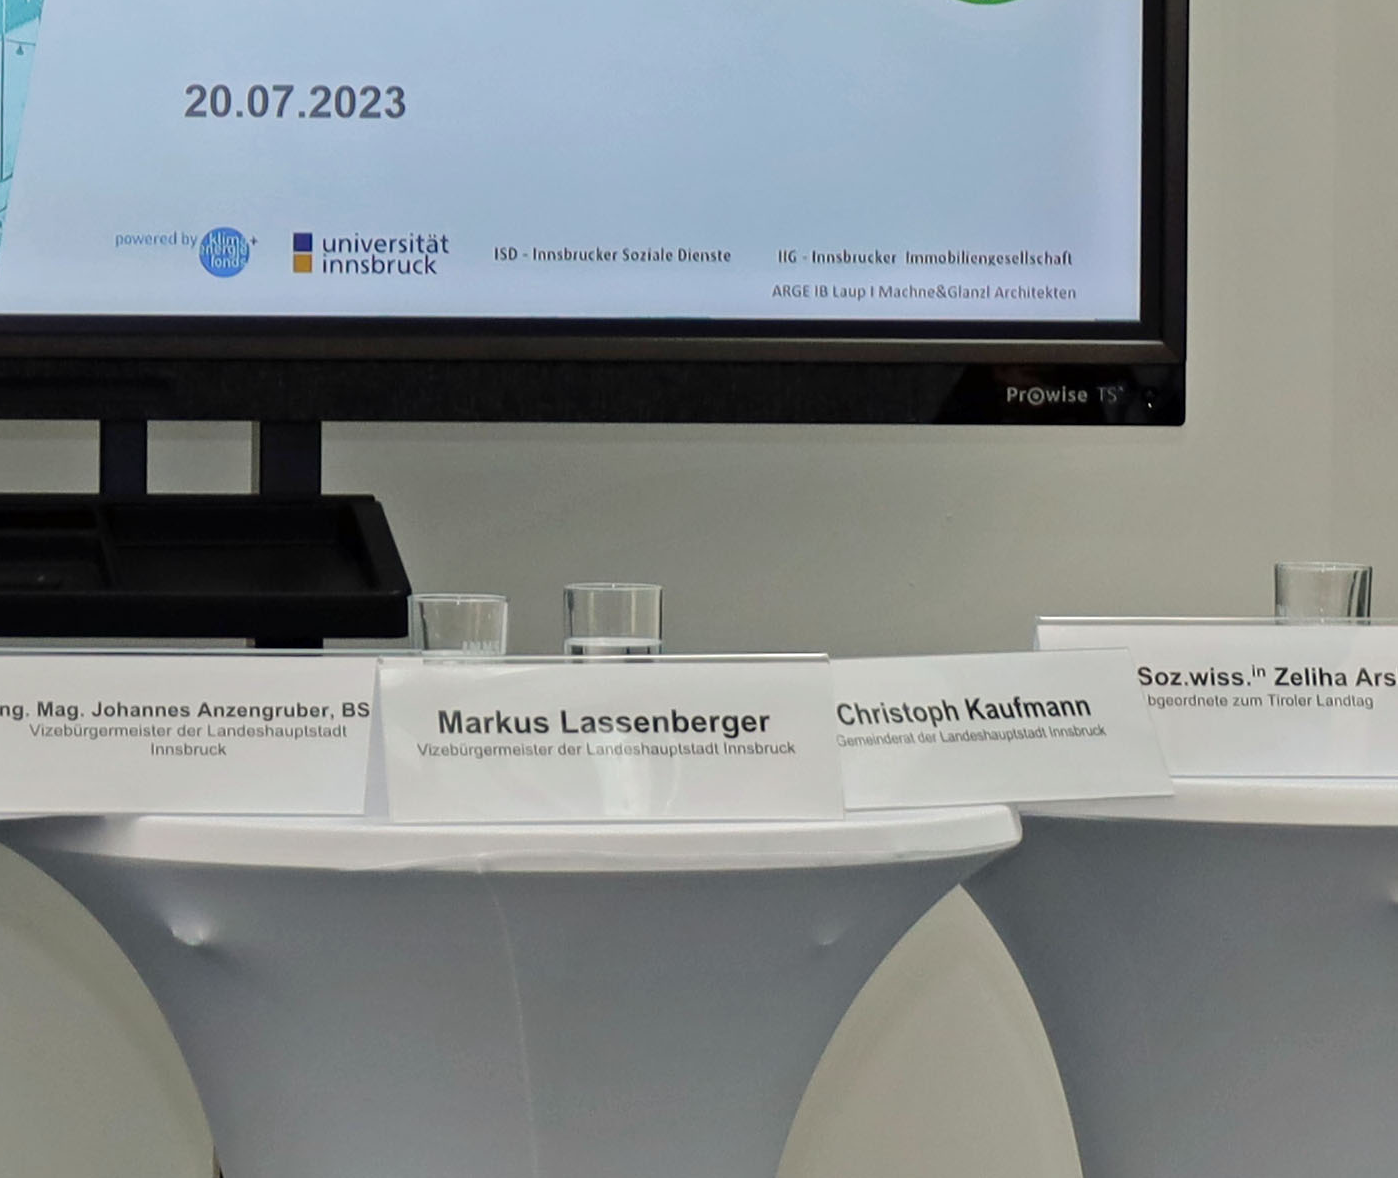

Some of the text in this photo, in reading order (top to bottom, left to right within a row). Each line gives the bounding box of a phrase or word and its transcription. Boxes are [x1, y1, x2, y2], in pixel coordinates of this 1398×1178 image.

[184, 84, 406, 119] 20.07.2023
[115, 231, 198, 249] powered by
[321, 232, 450, 255] universität
[321, 254, 438, 275] innsbruck
[493, 247, 519, 262] ISD
[532, 247, 618, 263] Innsbrucker
[621, 248, 674, 263] Soziale
[677, 249, 732, 264] Dienste
[777, 250, 798, 264] IIG
[811, 249, 897, 264] Innsbrucker
[905, 249, 1073, 266] Immobiliengesellschaft
[772, 284, 811, 298] ARGE
[833, 284, 866, 301] Laup
[878, 283, 991, 299] Machne&Glanzl
[993, 284, 1077, 299] Architekten
[1273, 667, 1348, 688] Zeliha
[36, 700, 85, 723] Mag.
[91, 700, 192, 719] Johannes
[196, 701, 335, 723] Anzengruber,
[341, 701, 371, 719] BS
[836, 694, 1092, 729] Christoph Kaufmann
[1147, 694, 1375, 711] bgeordnete zum Tiroler Landtag
[28, 723, 349, 742] Vizebürgermeister der Landeshauptstadt
[437, 709, 771, 740] Markus Lassenberger
[836, 723, 1108, 749] Gemeinderat der Landeshauptstadt Innsbruck
[150, 742, 228, 758] Innsbruck
[416, 741, 797, 760] Vizebürgermeister der Landeshauptstadt Innsbruck
